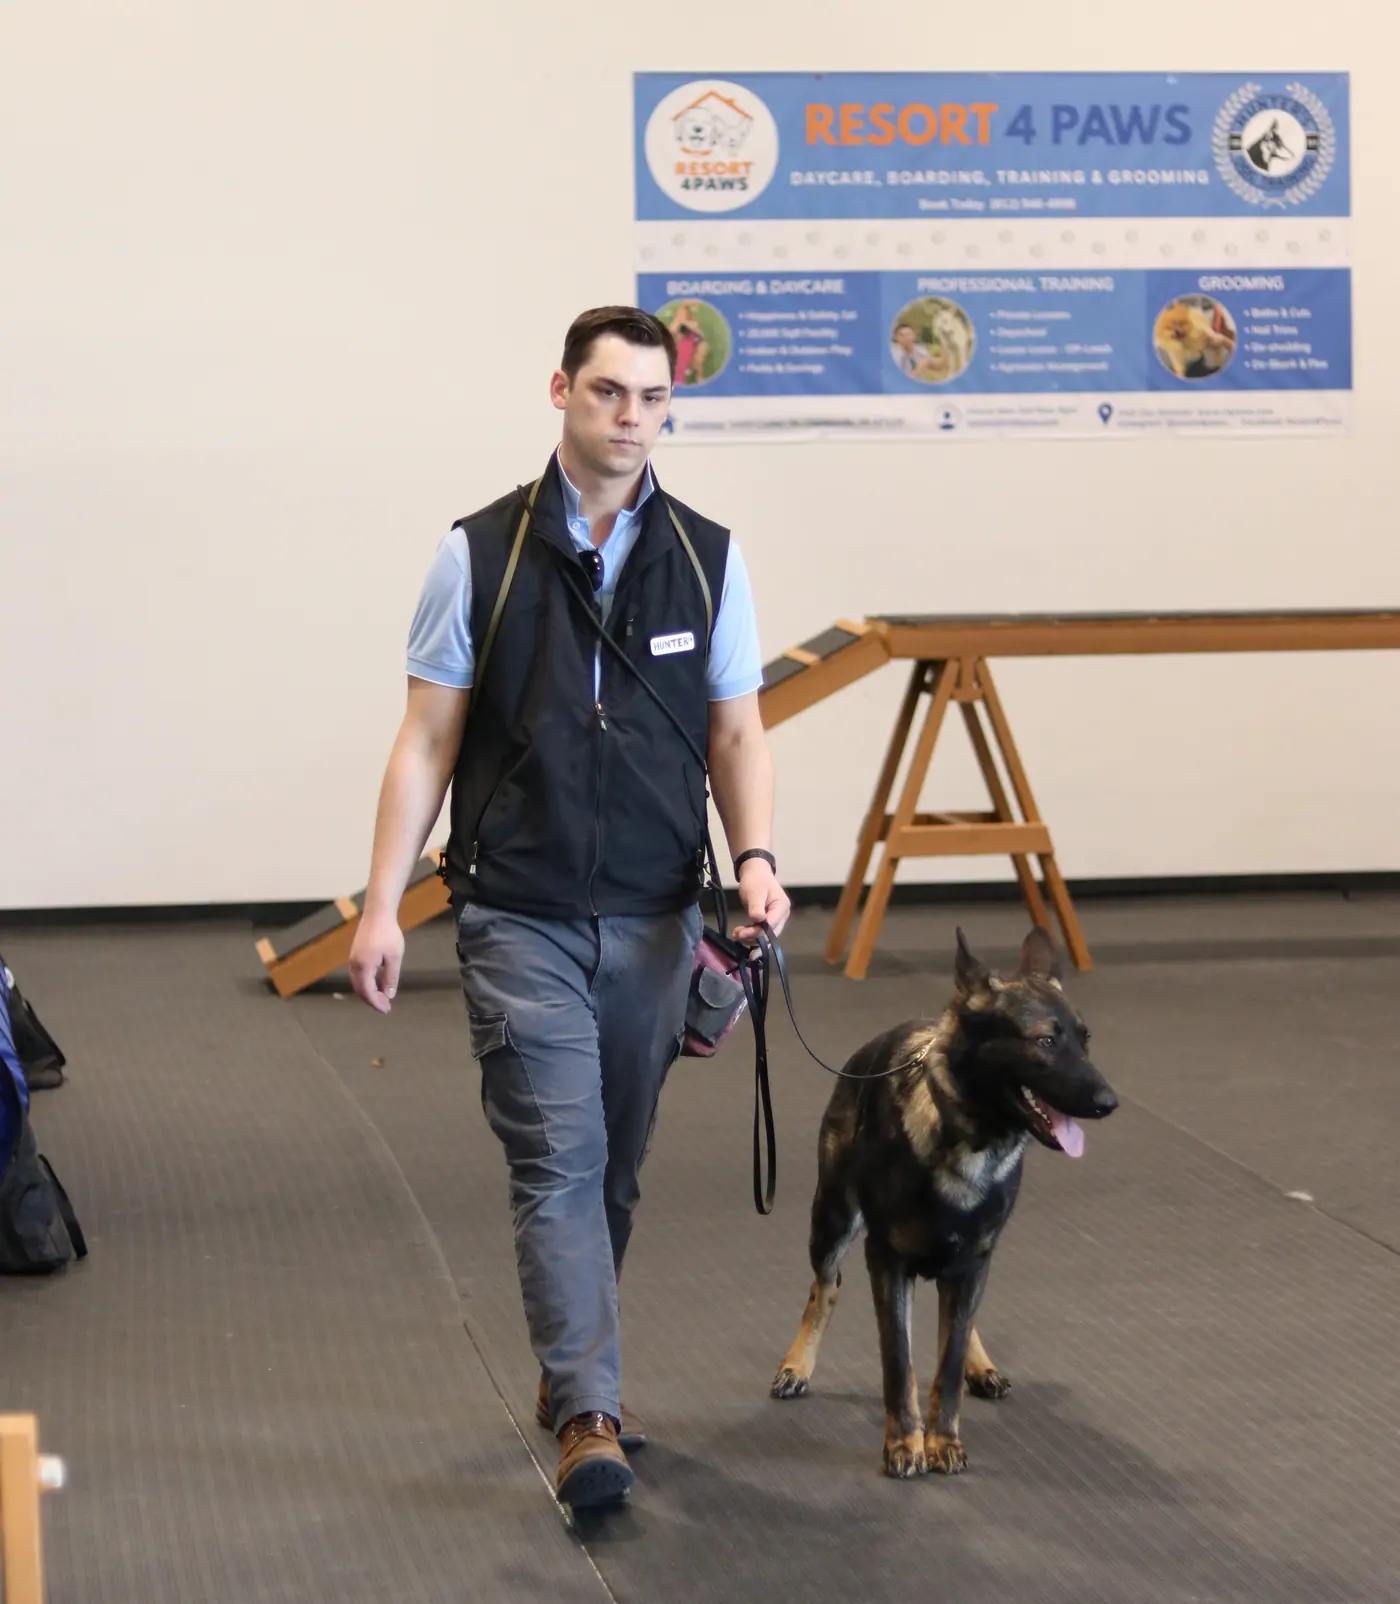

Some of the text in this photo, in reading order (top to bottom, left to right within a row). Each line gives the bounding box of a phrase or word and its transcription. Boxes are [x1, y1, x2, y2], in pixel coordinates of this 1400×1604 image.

[804, 103, 1192, 146] RESORT 4 PAWS
[675, 161, 753, 176] RESORT
[680, 176, 749, 190] 4PAWS
[789, 168, 1210, 187] DAYCARE, BOARDING, TRAINING & GROOMING
[666, 278, 845, 296] BOARDING & DAYCARE
[917, 275, 1115, 292] PROFESSIONAL TRAINING
[1198, 275, 1285, 291] GROOMING
